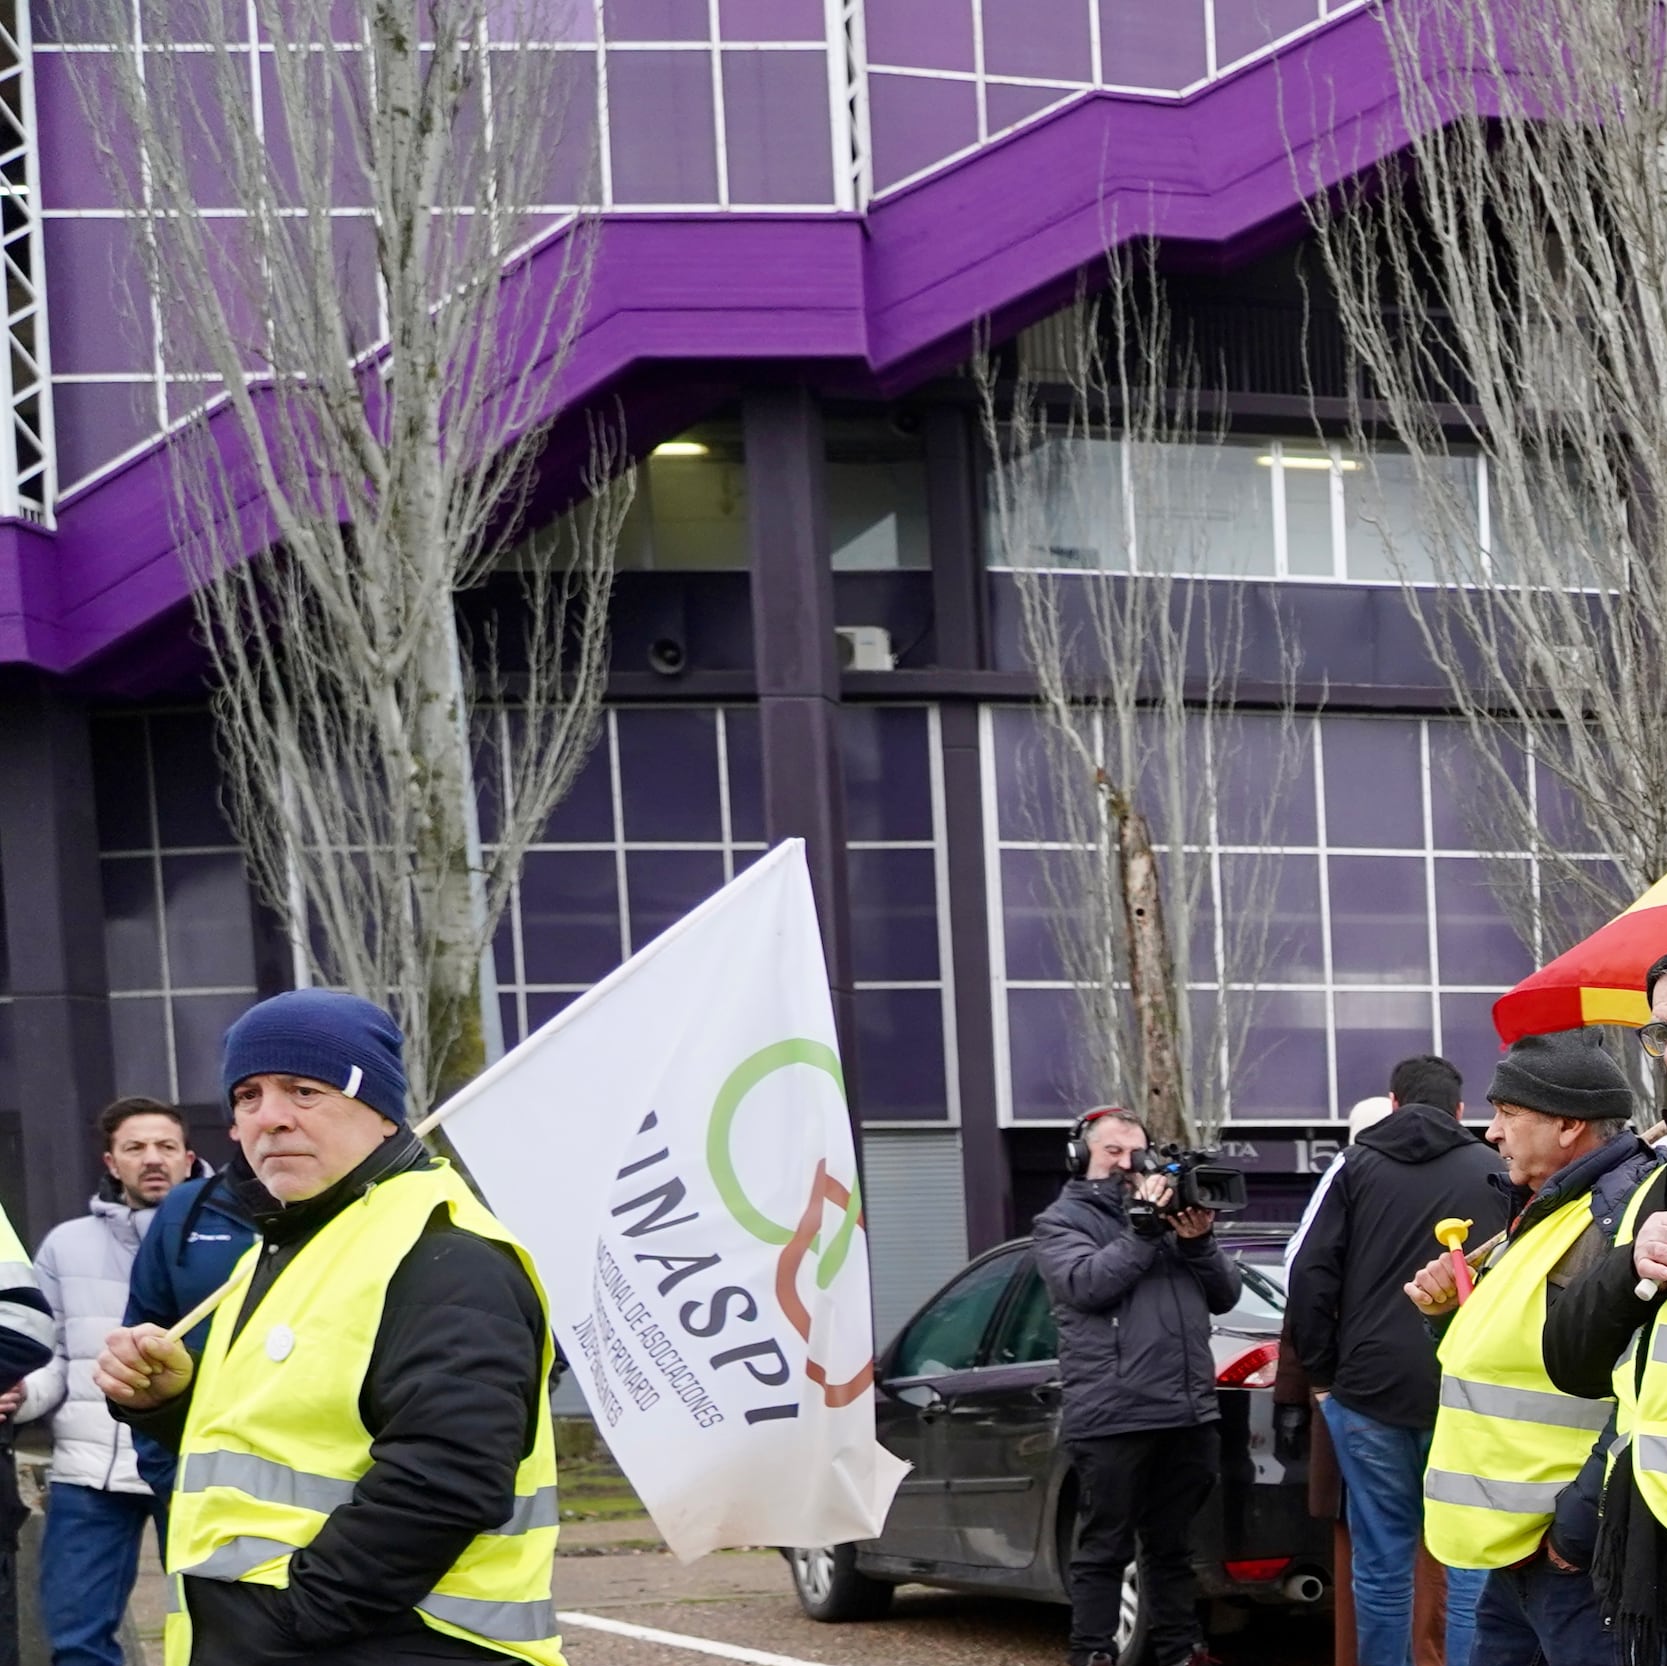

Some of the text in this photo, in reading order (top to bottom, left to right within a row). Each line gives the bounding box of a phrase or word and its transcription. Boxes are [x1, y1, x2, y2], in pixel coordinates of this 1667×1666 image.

[624, 1302, 652, 1332] DE
[608, 1338, 661, 1412] PRIMARIO
[637, 1323, 725, 1429] ASOCIACIONES
